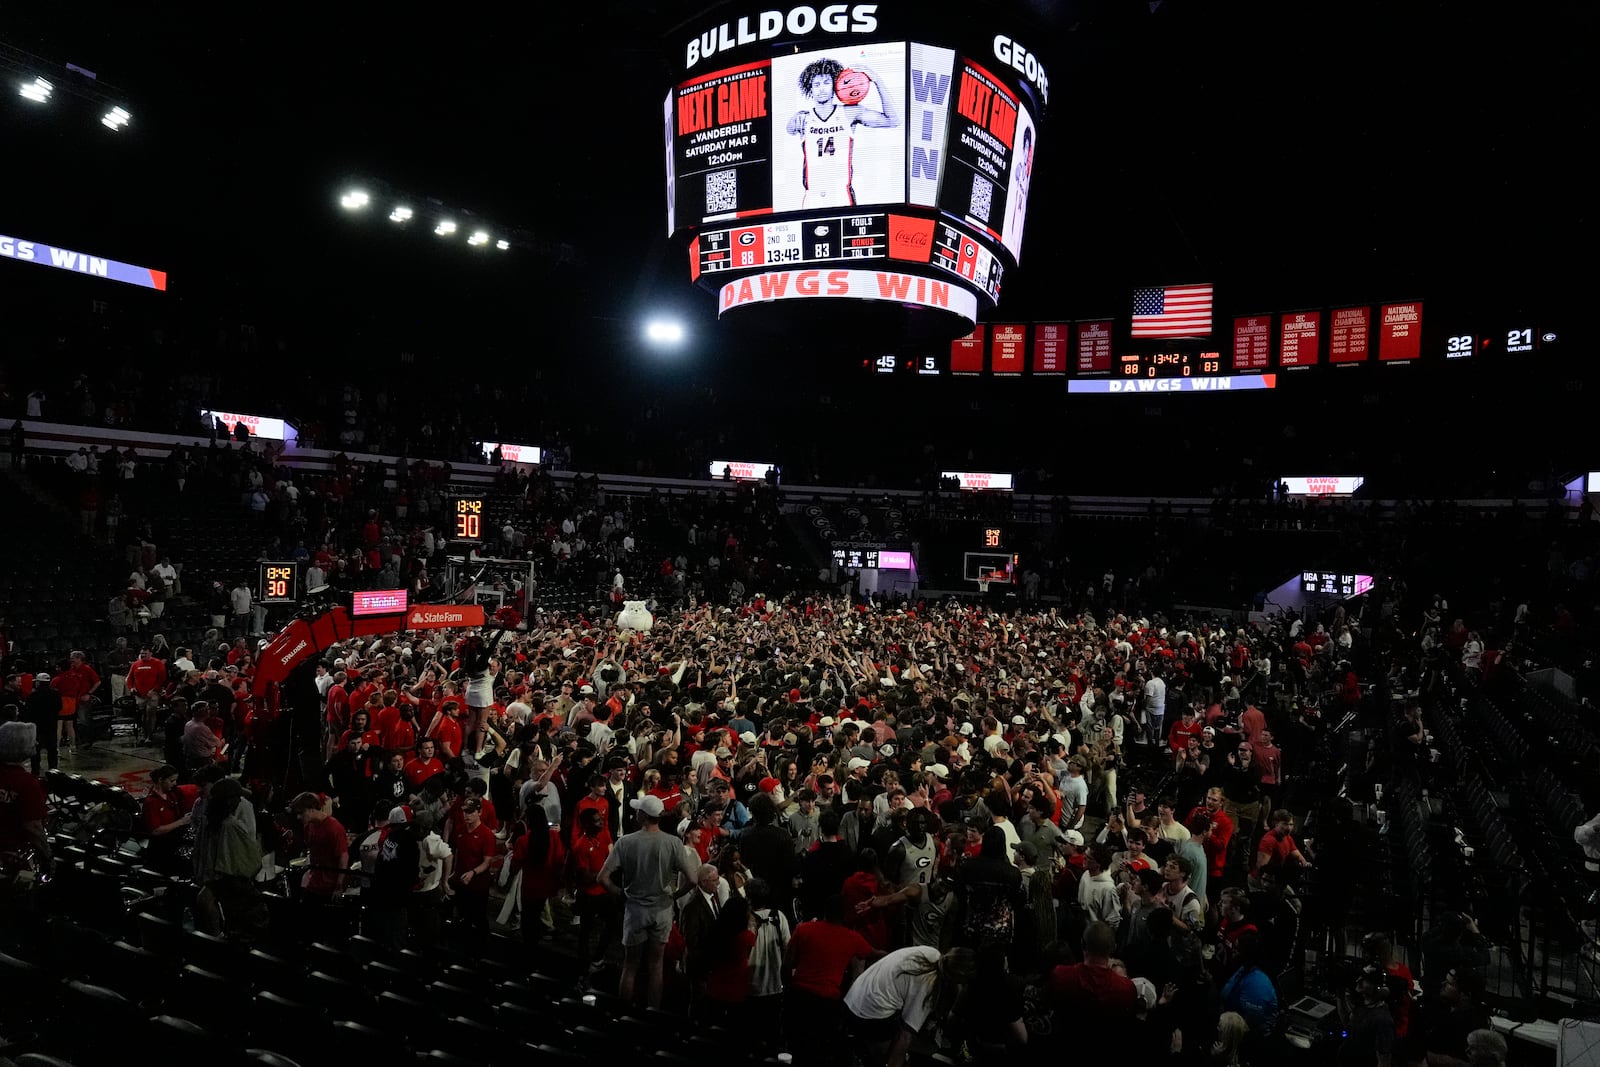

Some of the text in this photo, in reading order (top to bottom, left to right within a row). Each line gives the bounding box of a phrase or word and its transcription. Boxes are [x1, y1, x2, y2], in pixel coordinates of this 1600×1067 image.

[686, 5, 878, 69] BULLDOGS
[678, 75, 766, 137] NEXT GAME
[957, 71, 993, 129] NEXT
[810, 126, 844, 135] GEORGIA
[911, 69, 951, 181] WIN
[695, 122, 752, 142] VANDERBILT
[686, 135, 757, 158] SATURDAY MAR 8
[816, 136, 836, 158] 14
[708, 153, 743, 166] 12:00PM
[852, 218, 872, 227] FOULS
[767, 248, 800, 263] 13:42
[815, 243, 829, 258] 83
[49, 247, 108, 277] WIN
[742, 250, 754, 265] 88
[725, 271, 950, 307] DAWGS WIN
[1337, 310, 1363, 319] NATIONAL
[1388, 305, 1415, 314] NATIONAL
[1335, 317, 1366, 326] CHAMPIONS
[1385, 313, 1418, 322] CHAMPIONS
[1285, 321, 1316, 330] CHAMPIONS
[1448, 335, 1473, 351] 32
[1507, 328, 1532, 346] 21
[876, 355, 896, 368] 45
[925, 357, 935, 369] 5
[1153, 353, 1180, 364] 13:42
[1125, 364, 1139, 374] 88
[1148, 366, 1155, 376] 0
[1183, 365, 1190, 376] 0
[1204, 361, 1218, 372] 83
[1109, 377, 1231, 391] DAWGS WIN
[223, 413, 260, 424] DAWGS
[1309, 485, 1336, 493] WIN
[457, 500, 482, 513] 13:42
[457, 514, 479, 538] 30
[985, 535, 999, 546] 30
[267, 567, 291, 580] 13:42
[1341, 575, 1353, 584] UF
[268, 581, 286, 596] 30
[280, 639, 308, 666] SPALDING
[916, 857, 930, 869] G
